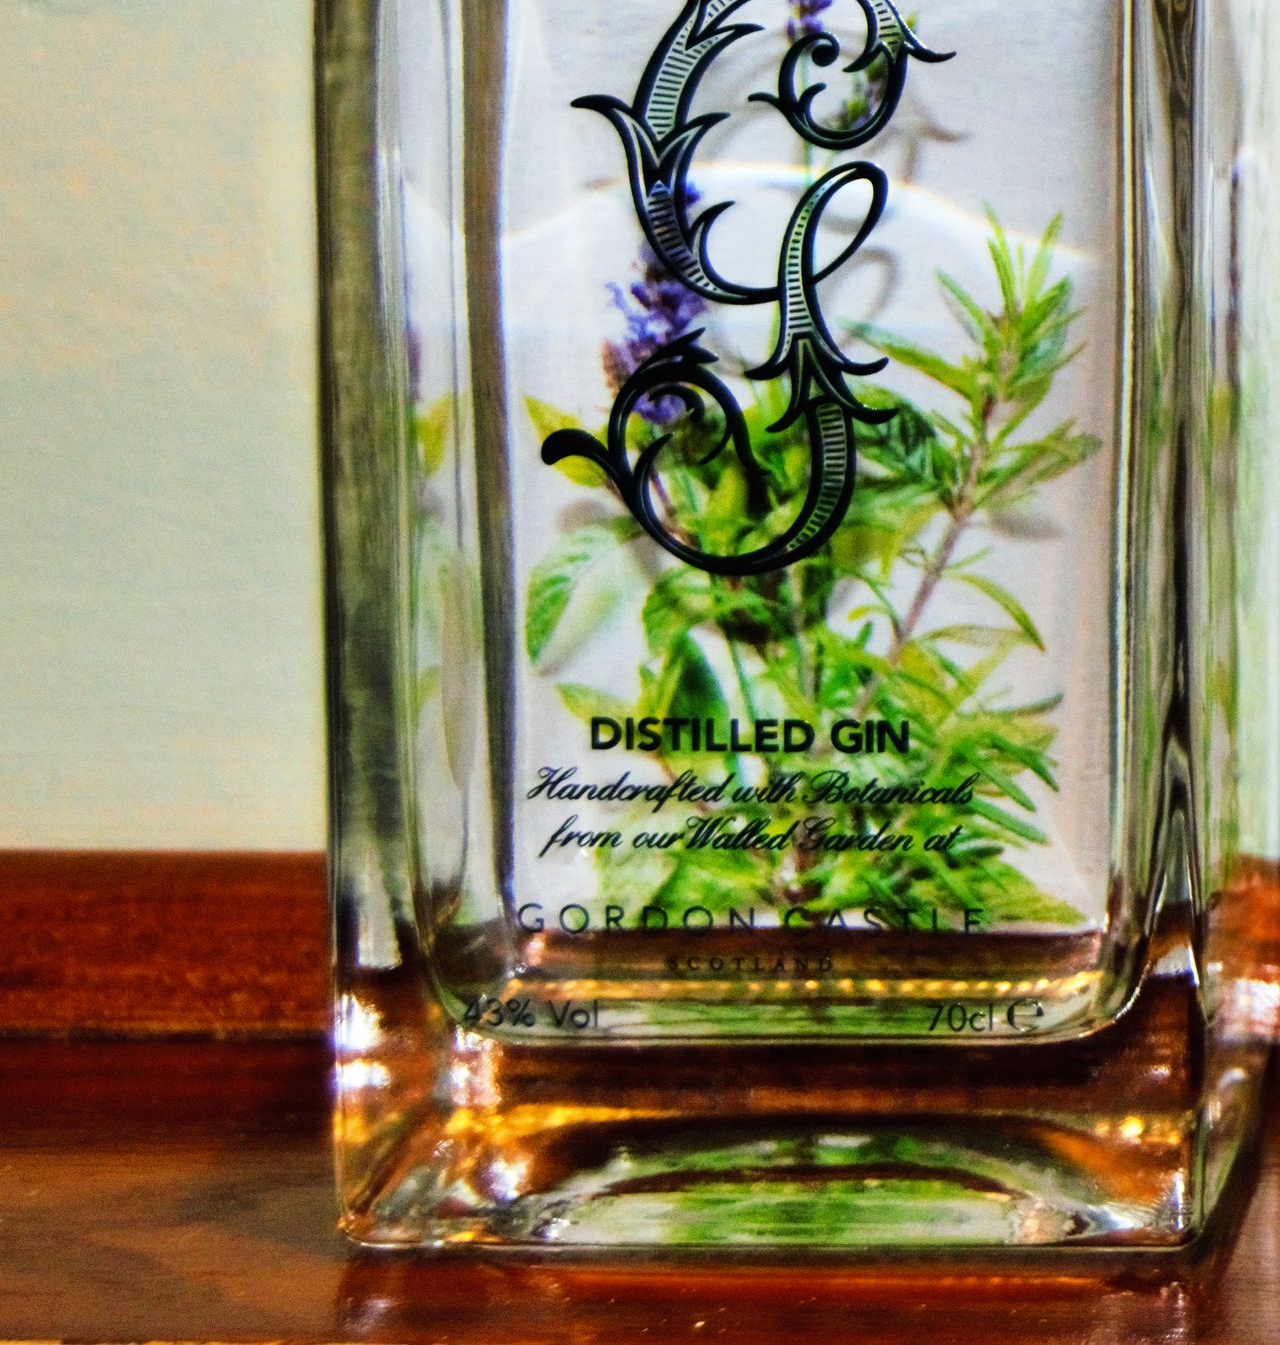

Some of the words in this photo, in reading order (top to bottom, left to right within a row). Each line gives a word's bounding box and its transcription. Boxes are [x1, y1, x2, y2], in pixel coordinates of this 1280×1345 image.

[590, 716, 816, 753] DISTILLED
[830, 718, 910, 754] GIN
[527, 765, 726, 813] Handcrafted
[731, 770, 802, 804] with
[804, 770, 975, 806] Botanicals
[541, 815, 623, 858] from
[634, 830, 684, 850] our
[685, 817, 791, 853] Walled
[797, 816, 916, 854] Garden
[925, 824, 964, 852] at
[517, 903, 757, 935] GORDON
[784, 905, 985, 936] CASTLE
[666, 956, 834, 973] SCOTLAND
[464, 997, 536, 1028] 43%
[547, 999, 599, 1029] Vol
[926, 1001, 993, 1032] 70cl
